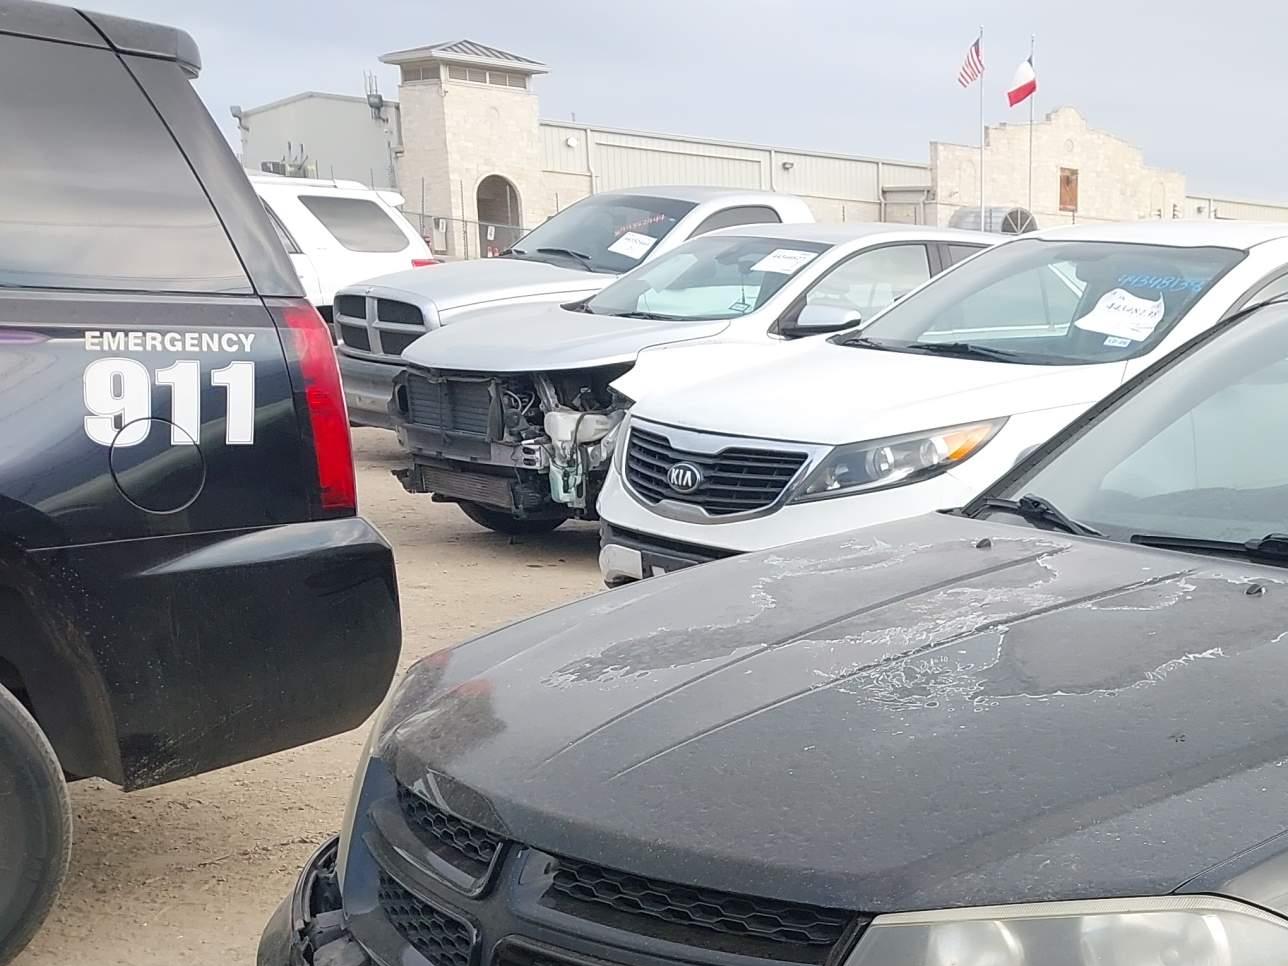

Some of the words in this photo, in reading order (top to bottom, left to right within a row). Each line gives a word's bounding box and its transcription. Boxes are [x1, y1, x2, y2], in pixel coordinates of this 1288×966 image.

[84, 331, 255, 352] EMERGENCY
[83, 357, 255, 447] 911
[671, 468, 691, 487] KIA
